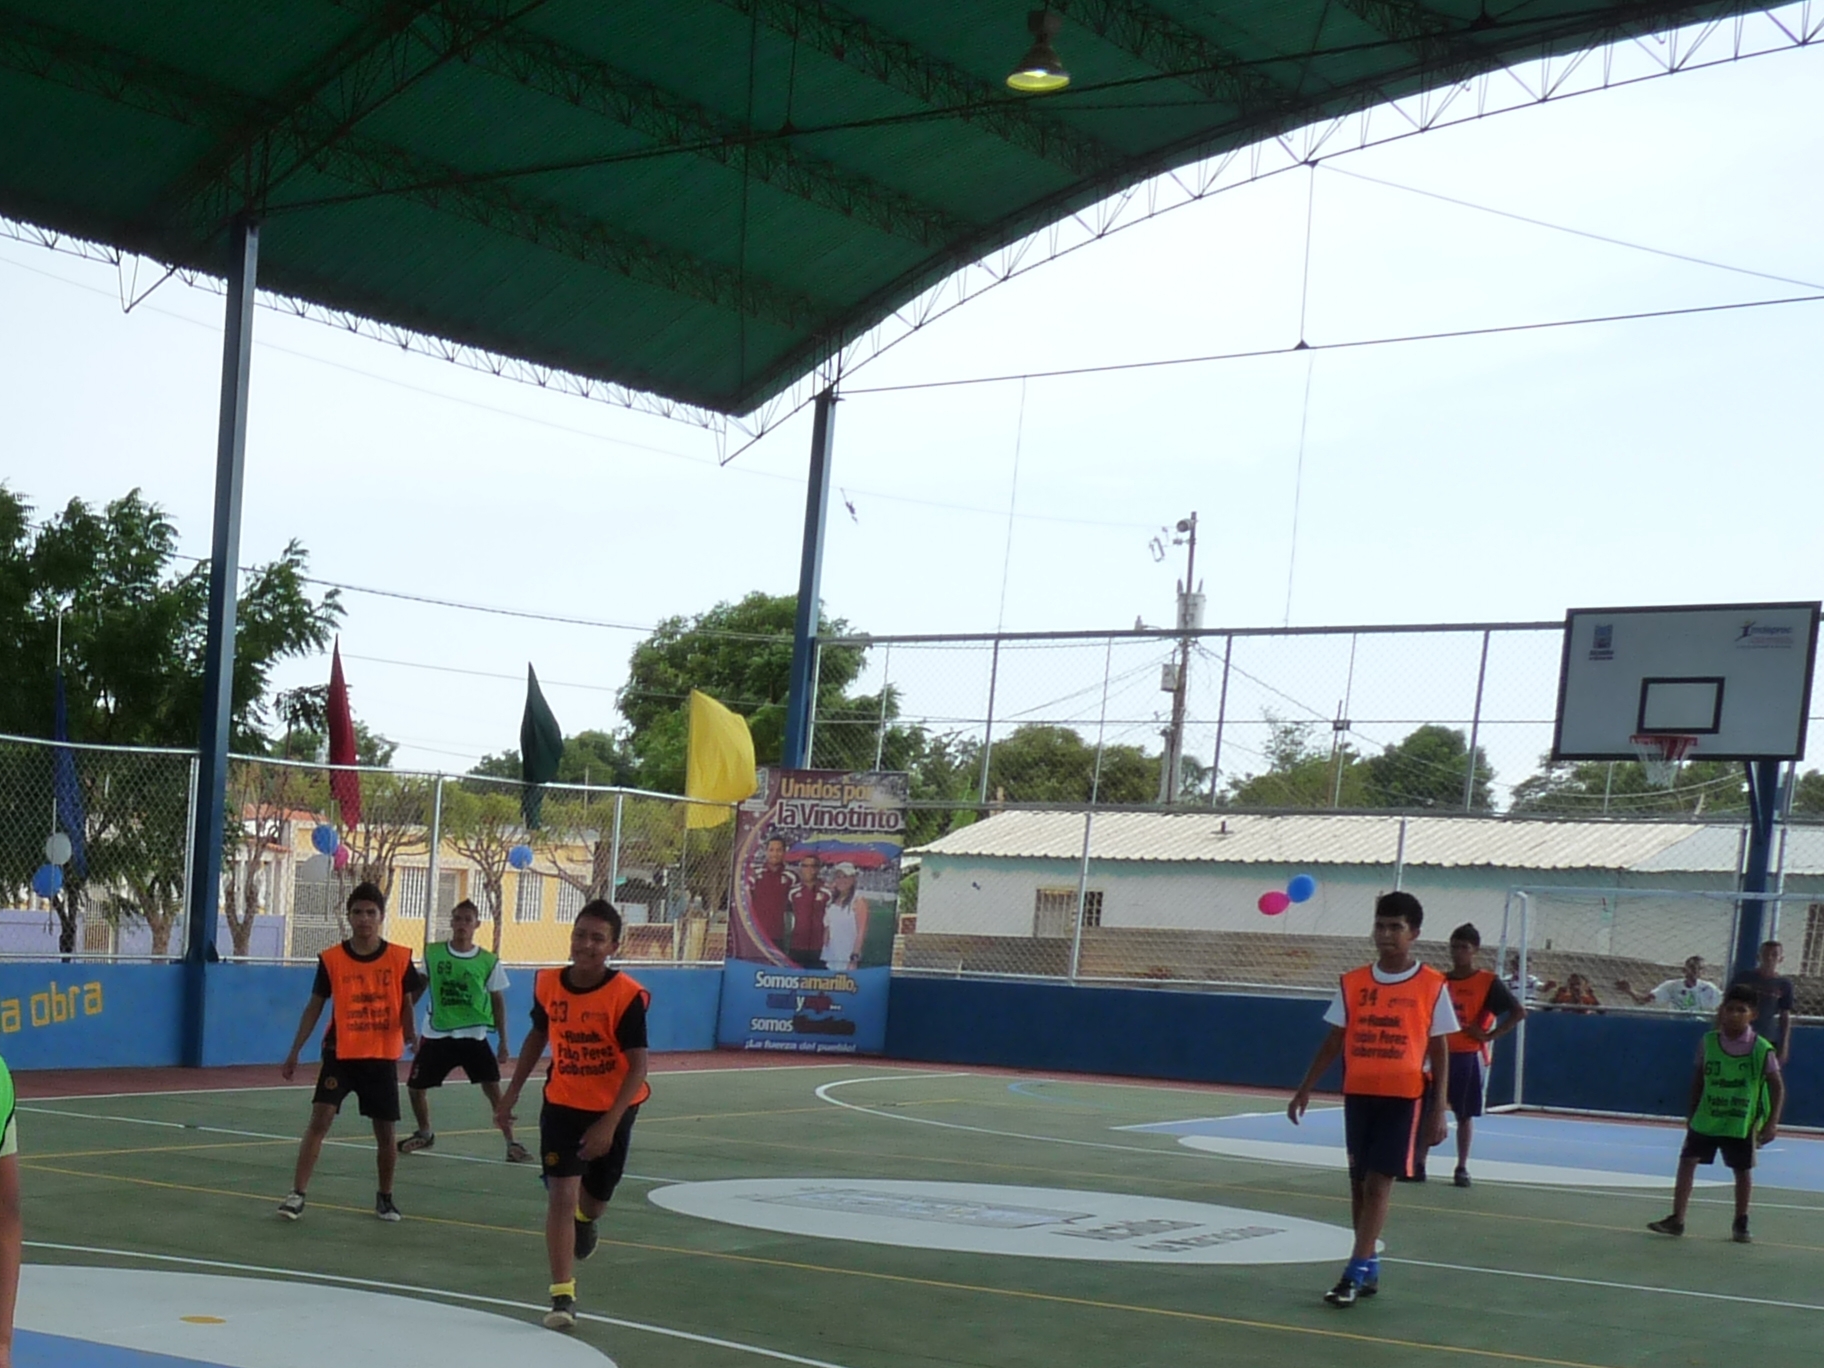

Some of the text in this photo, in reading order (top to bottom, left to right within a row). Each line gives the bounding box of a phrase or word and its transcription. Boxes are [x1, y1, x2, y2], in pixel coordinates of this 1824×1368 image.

[781, 777, 875, 804] Unidos por
[777, 801, 900, 829] la Vinotinto
[755, 971, 857, 993] Somos amarillo,
[30, 981, 103, 1027] obra
[796, 996, 805, 1012] y
[751, 1018, 794, 1032] somos
